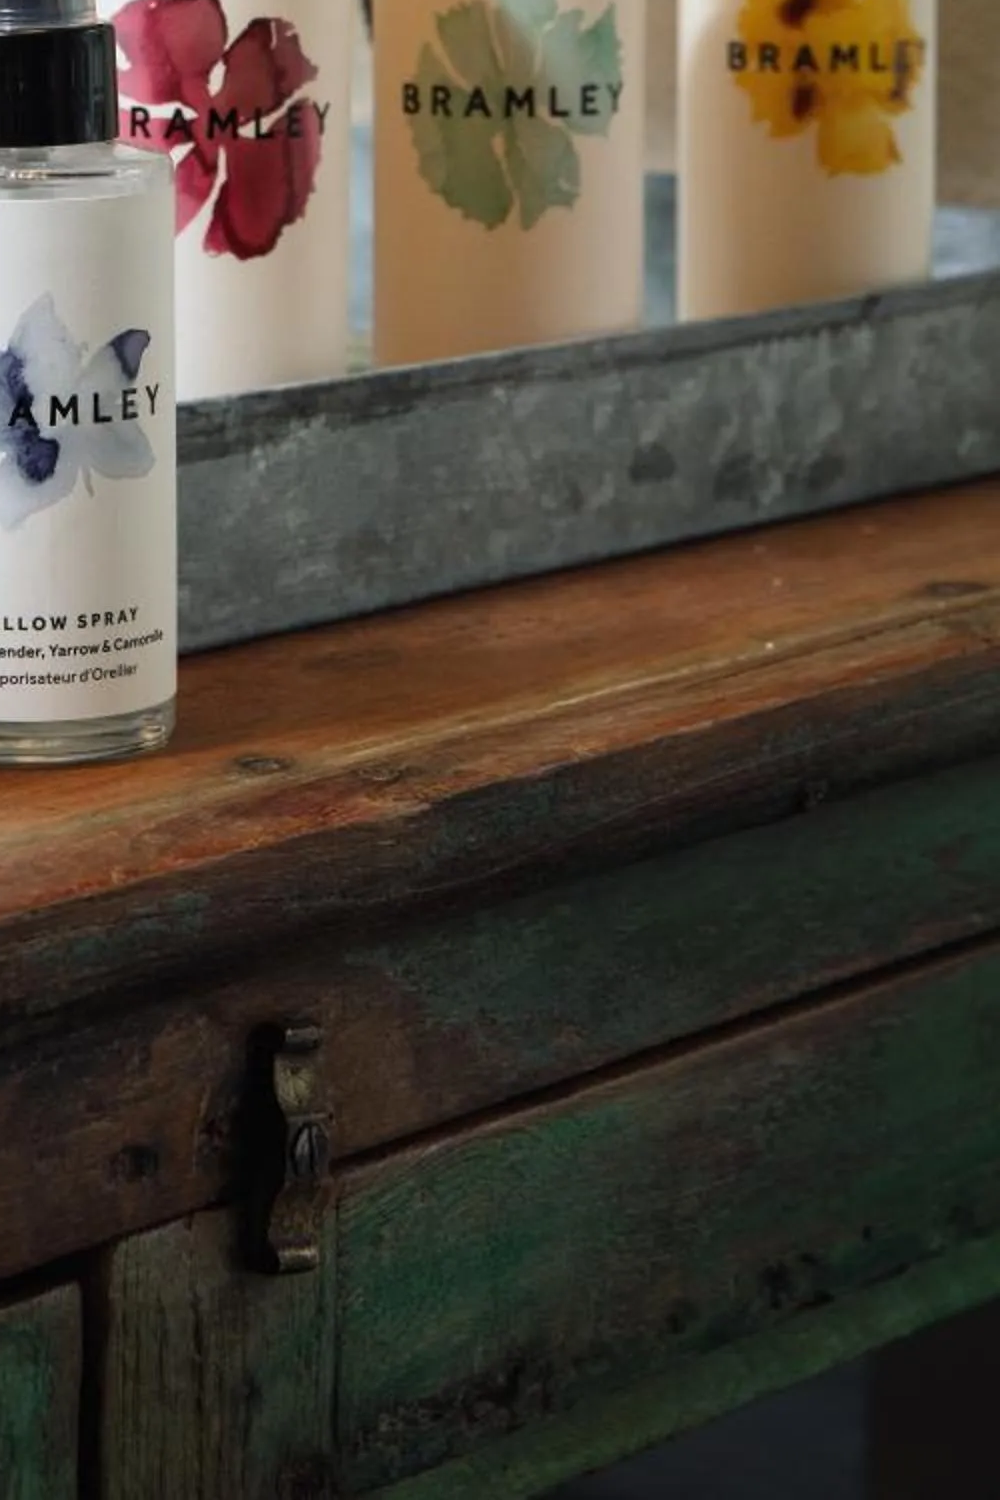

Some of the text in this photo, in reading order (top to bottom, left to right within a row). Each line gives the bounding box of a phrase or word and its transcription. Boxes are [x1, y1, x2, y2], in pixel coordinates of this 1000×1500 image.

[727, 40, 925, 74] BRAML
[402, 82, 624, 119] BRAMLEY
[130, 101, 331, 140] RAMLEY
[77, 607, 138, 630] SPRAY
[49, 644, 99, 658] Yarrow
[102, 640, 111, 653] &
